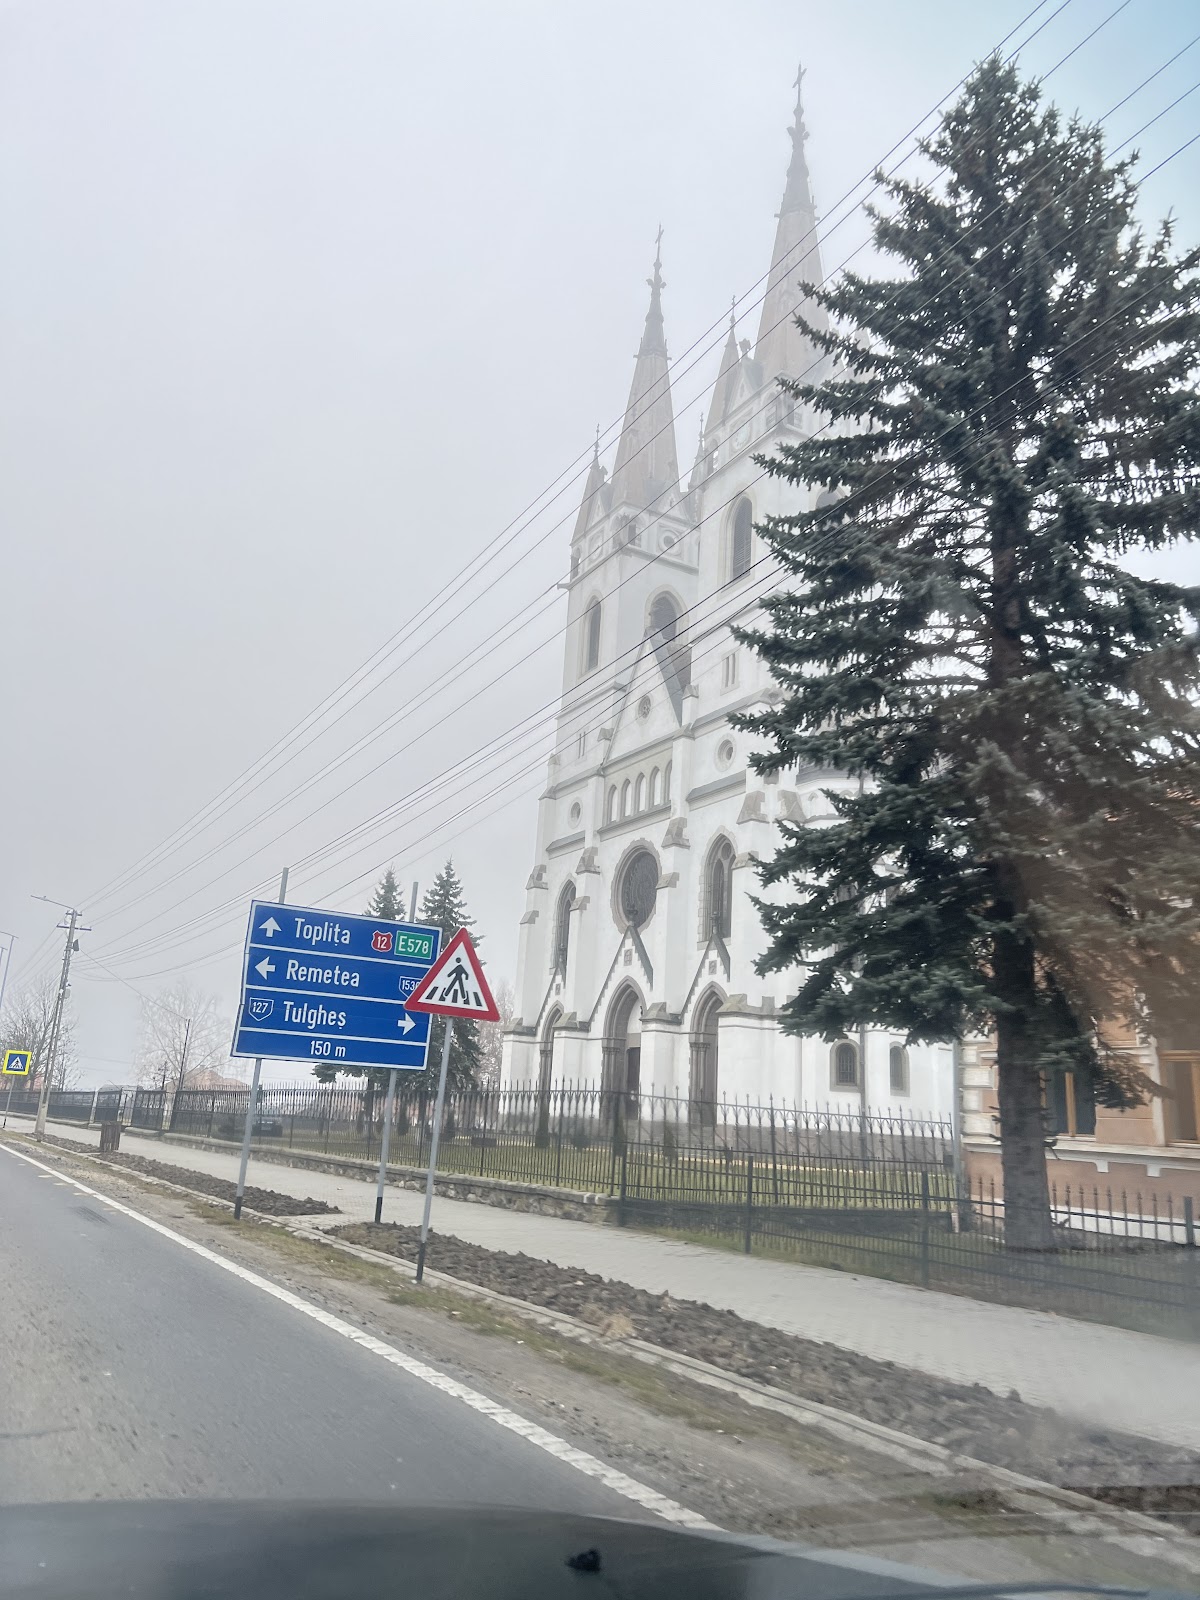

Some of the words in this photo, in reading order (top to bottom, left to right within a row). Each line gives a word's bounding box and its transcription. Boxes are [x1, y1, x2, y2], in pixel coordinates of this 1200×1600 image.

[295, 917, 350, 946] Toplița
[377, 936, 387, 949] 12
[398, 936, 428, 954] E578
[286, 960, 360, 987] Remetea
[252, 1002, 268, 1013] 127
[283, 1001, 346, 1029] Tulgheș
[310, 1041, 331, 1056] 150
[335, 1046, 346, 1057] m
